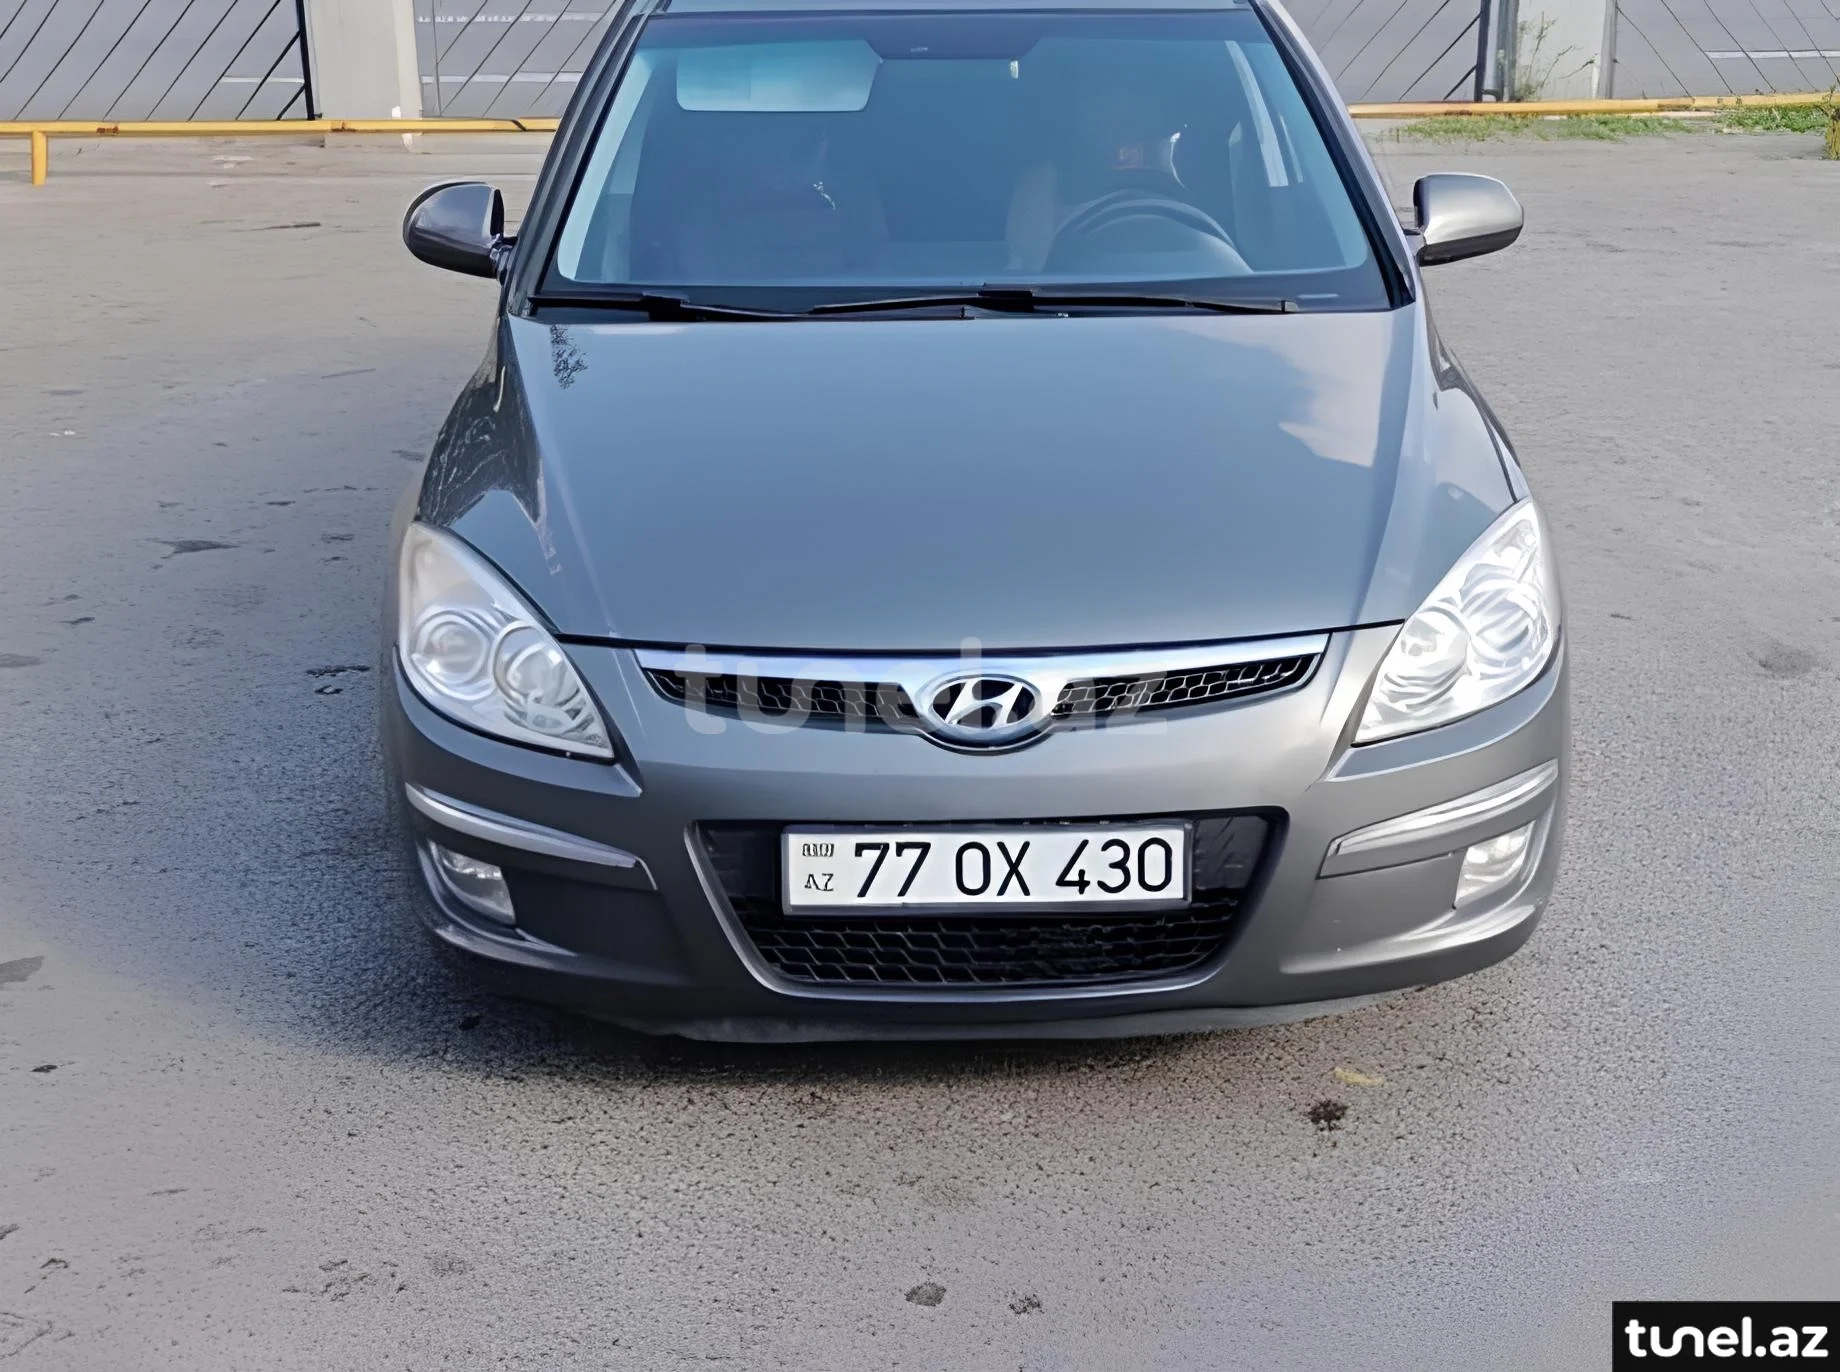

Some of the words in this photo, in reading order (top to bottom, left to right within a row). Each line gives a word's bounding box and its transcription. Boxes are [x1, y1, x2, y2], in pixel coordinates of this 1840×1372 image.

[854, 841, 932, 898] 77
[955, 841, 1031, 897] OX
[1055, 837, 1173, 894] 430
